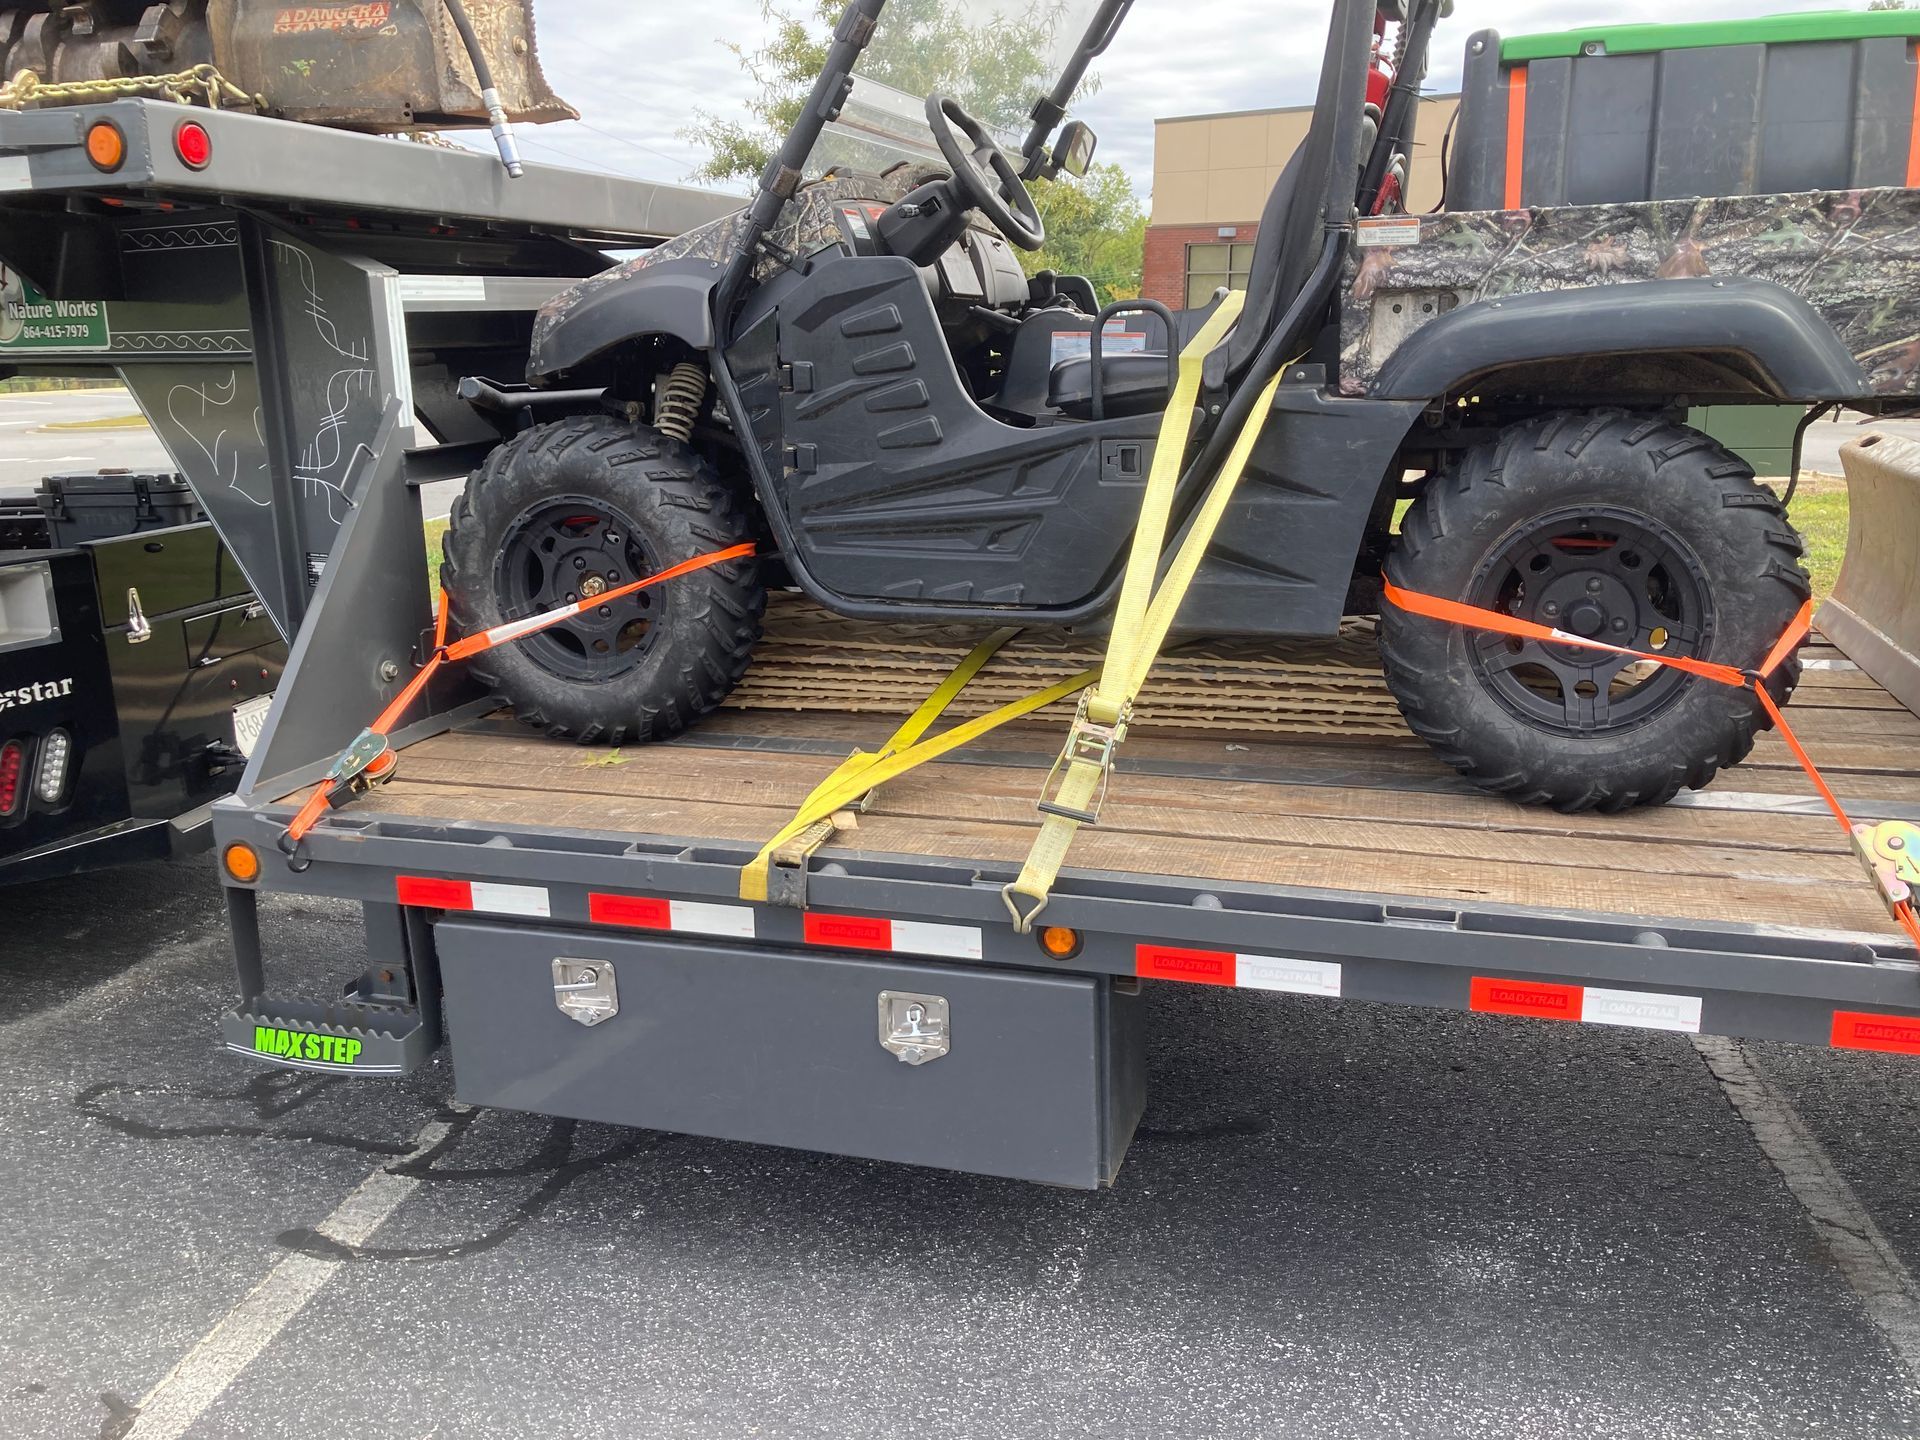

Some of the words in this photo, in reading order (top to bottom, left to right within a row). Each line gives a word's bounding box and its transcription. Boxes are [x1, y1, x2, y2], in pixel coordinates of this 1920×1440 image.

[293, 5, 371, 22] DANGER
[8, 302, 53, 319] Nature
[55, 300, 98, 318] Works
[23, 324, 89, 339] 864-415-7979
[254, 1026, 363, 1065] MAXSTEP
